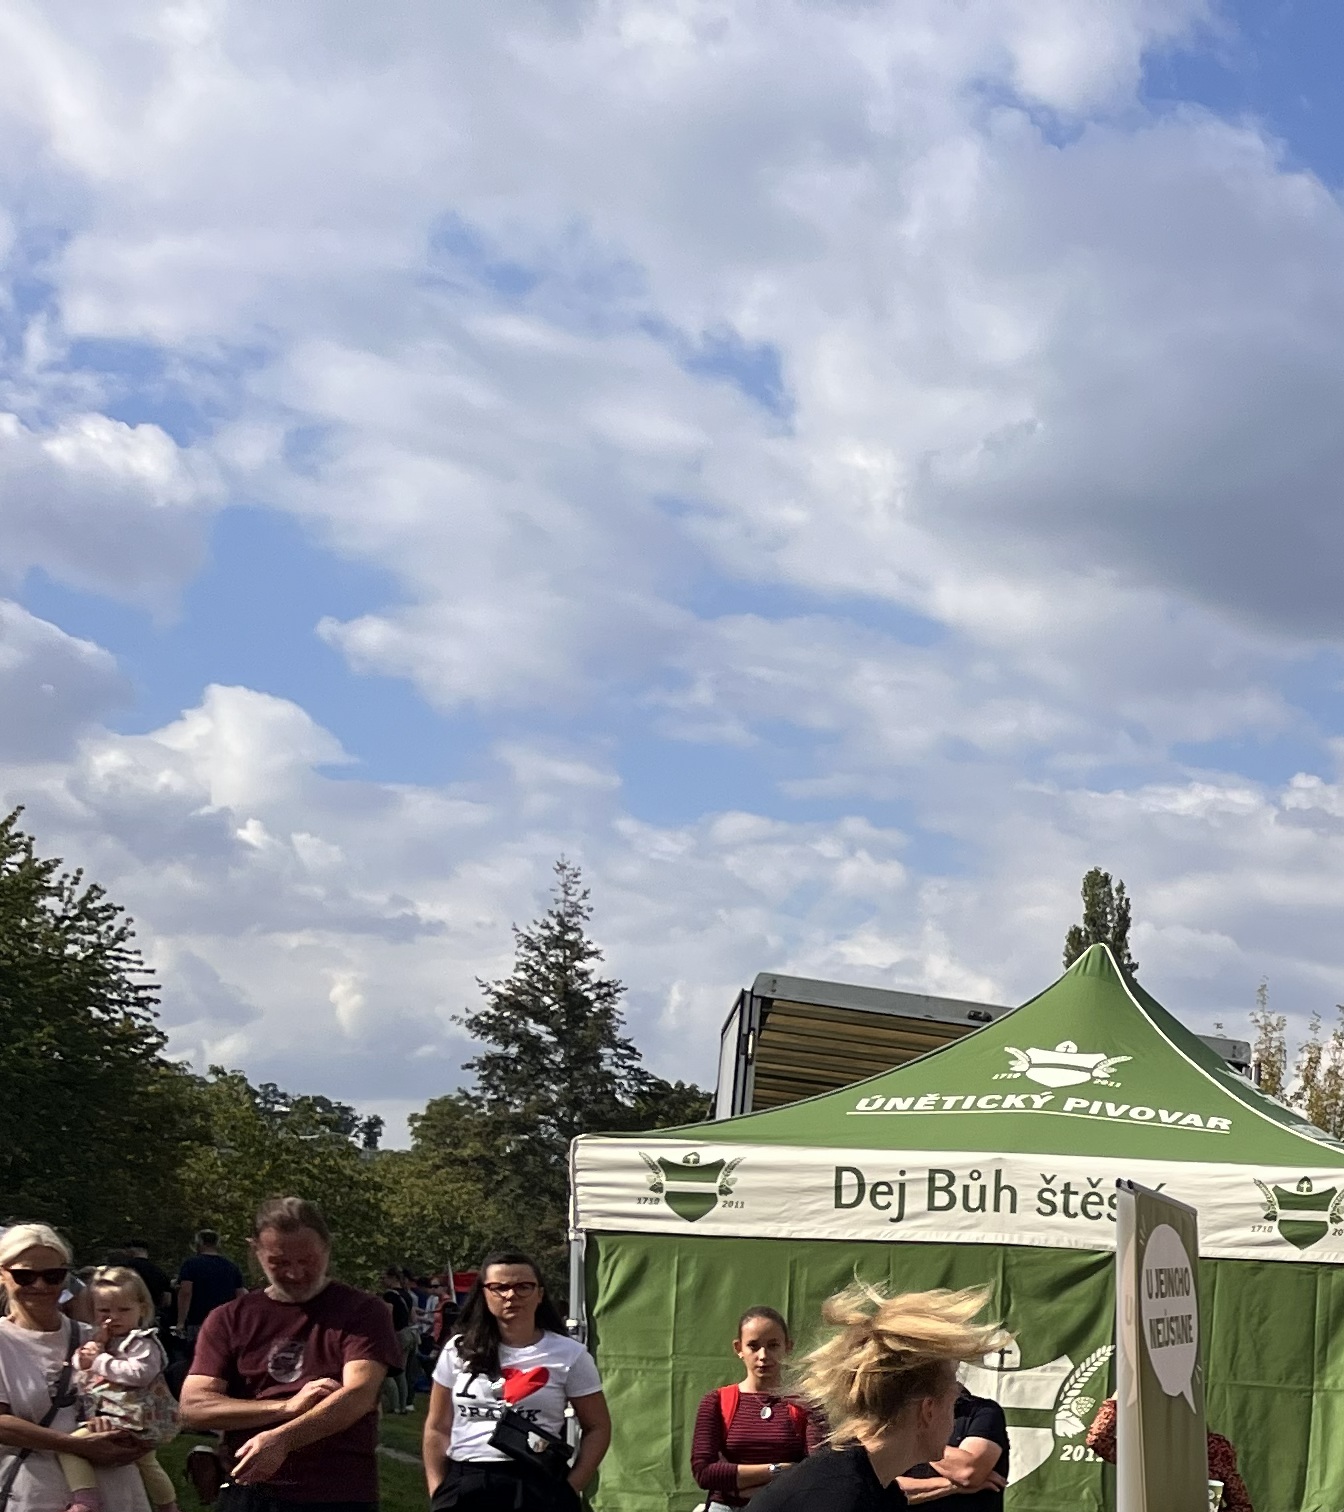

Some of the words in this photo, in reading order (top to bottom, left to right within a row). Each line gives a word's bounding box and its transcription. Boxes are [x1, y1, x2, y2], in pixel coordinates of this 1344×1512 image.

[854, 1091, 1056, 1113] ÚNĚTICKÝ
[1062, 1097, 1234, 1132] PIVOVAR
[722, 1200, 745, 1209] 2011
[834, 1165, 907, 1223] Dej
[927, 1168, 1017, 1214] Bůh
[1146, 1268, 1153, 1299] U
[1060, 1444, 1104, 1463] 201
